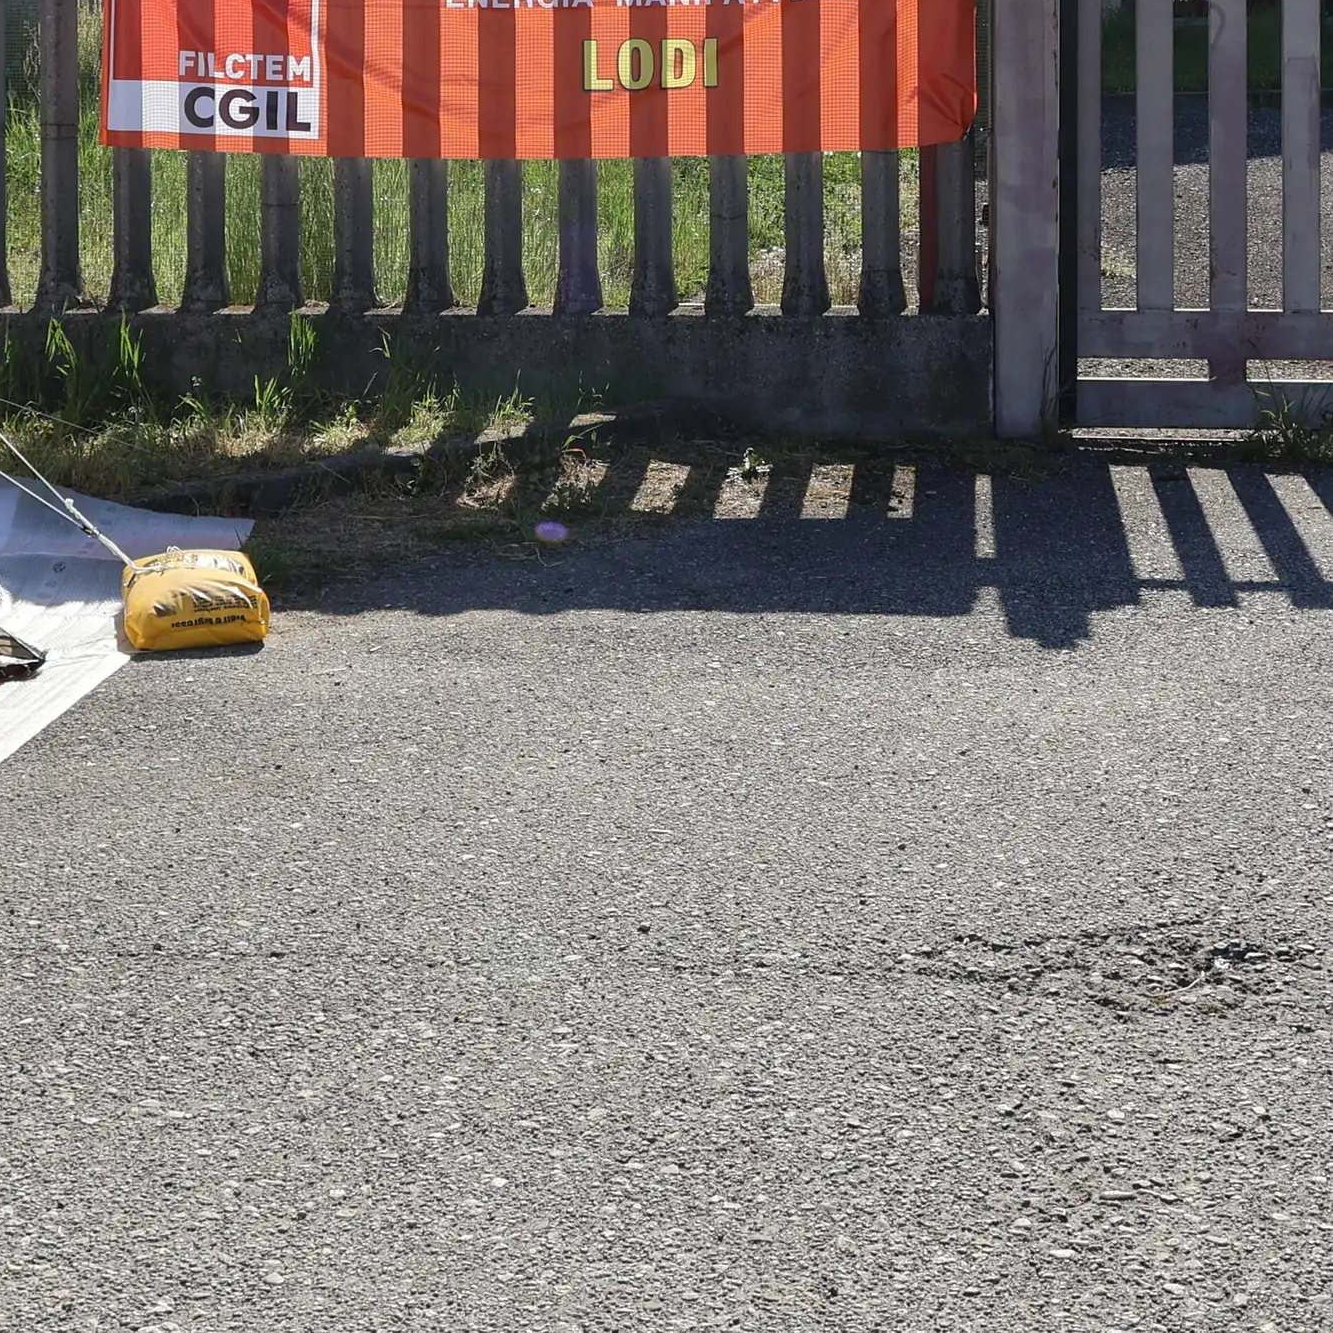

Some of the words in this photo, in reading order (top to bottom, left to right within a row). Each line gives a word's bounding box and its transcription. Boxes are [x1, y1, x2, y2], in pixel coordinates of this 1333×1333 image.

[178, 49, 312, 82] FILCTEM
[582, 37, 719, 91] LODI
[183, 85, 312, 132] CGIL
